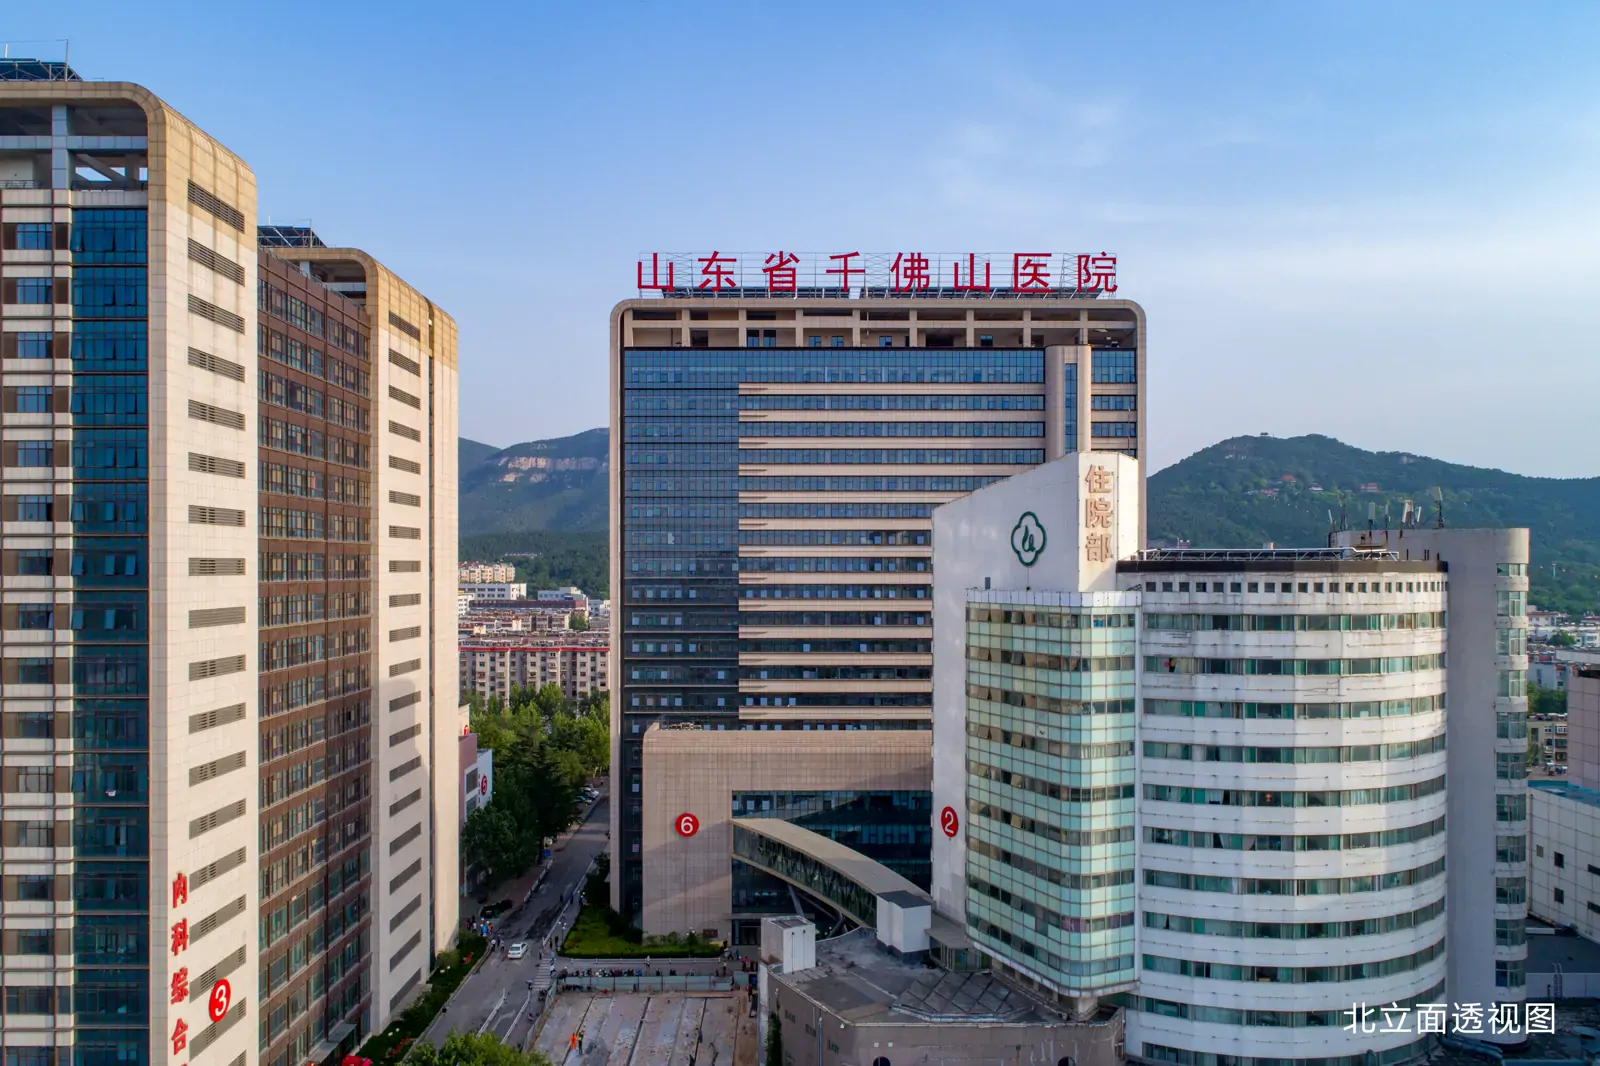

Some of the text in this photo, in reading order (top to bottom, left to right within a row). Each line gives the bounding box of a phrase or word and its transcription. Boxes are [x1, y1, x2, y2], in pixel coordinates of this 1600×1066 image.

[638, 251, 1118, 293] 山东省千佛山医院
[1085, 464, 1112, 562] 住院部
[171, 872, 190, 1066] 内科综合
